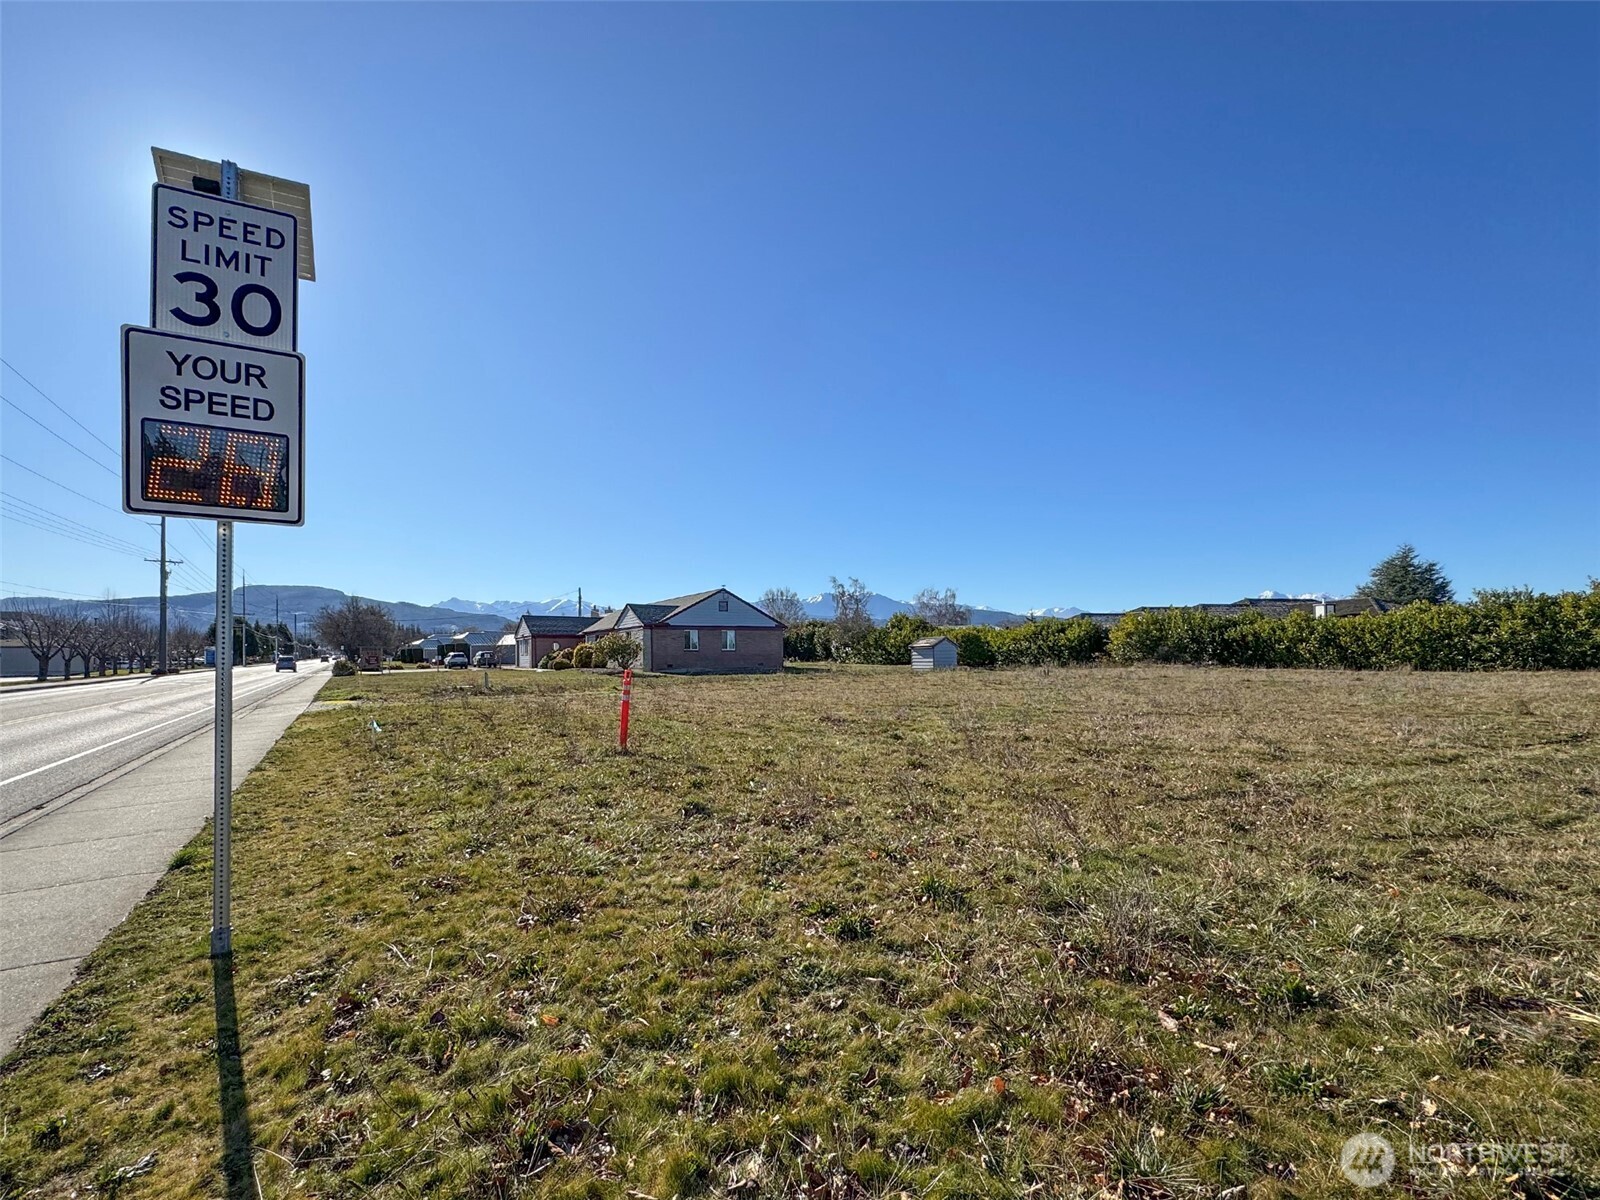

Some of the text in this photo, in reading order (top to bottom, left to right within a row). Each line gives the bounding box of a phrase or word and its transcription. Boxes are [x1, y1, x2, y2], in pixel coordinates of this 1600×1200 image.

[167, 206, 286, 250] SPEED
[181, 239, 272, 277] LIMIT
[169, 271, 282, 337] 30
[166, 350, 268, 389] YOUR
[159, 385, 275, 421] SPEED
